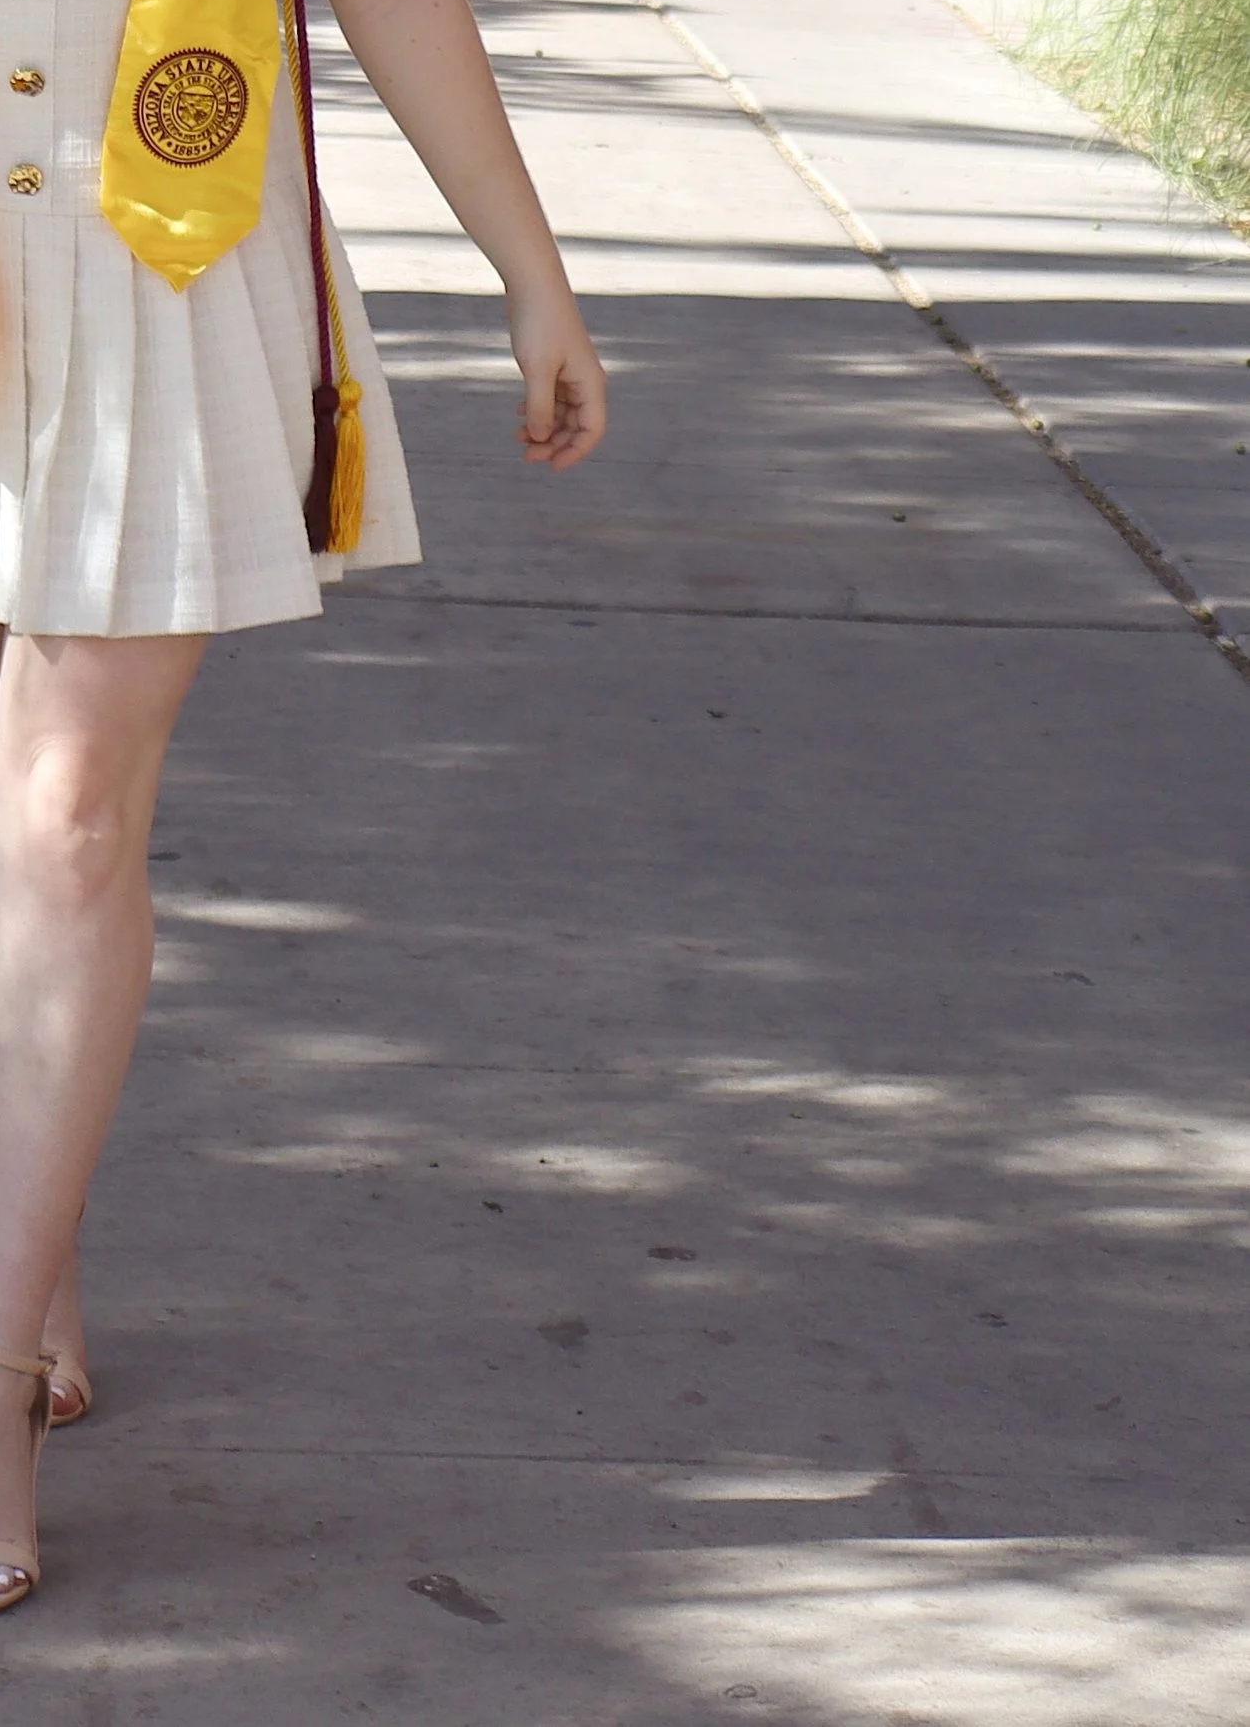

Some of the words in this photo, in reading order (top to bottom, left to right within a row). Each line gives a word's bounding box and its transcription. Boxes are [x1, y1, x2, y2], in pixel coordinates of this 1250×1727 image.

[146, 81, 168, 142] ARIZONA
[165, 59, 215, 80] STATE
[209, 66, 240, 149] UNIVERSITY
[173, 144, 201, 156] 1885
